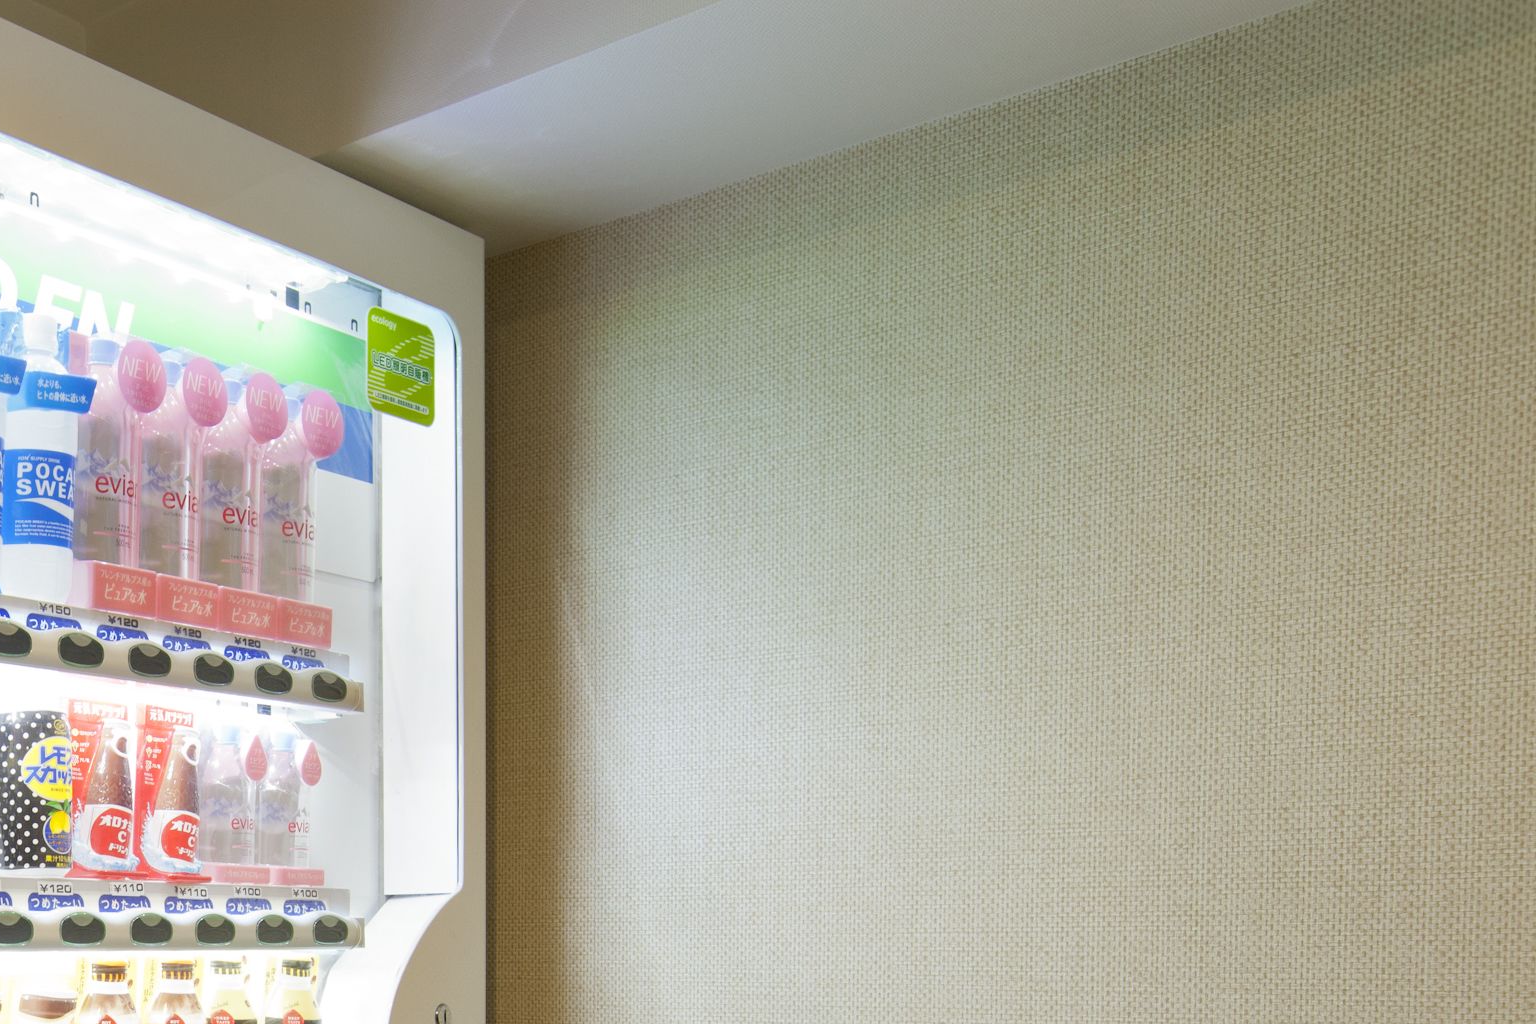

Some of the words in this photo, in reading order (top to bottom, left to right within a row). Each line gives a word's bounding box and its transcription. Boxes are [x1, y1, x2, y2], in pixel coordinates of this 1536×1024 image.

[371, 315, 397, 331] ecology
[122, 359, 162, 382] NEW
[187, 377, 223, 399] NEW
[249, 390, 284, 412] NEW
[305, 407, 339, 428] NEW
[39, 602, 71, 616] ¥150
[108, 615, 139, 629] ¥120
[174, 626, 202, 639] ¥120
[234, 636, 261, 649] ¥120
[290, 646, 317, 658] ¥120
[39, 883, 72, 894] ¥120
[114, 883, 144, 893] ¥110
[180, 888, 208, 898] ¥110
[235, 886, 261, 896] ¥100
[293, 889, 318, 898] ¥100
